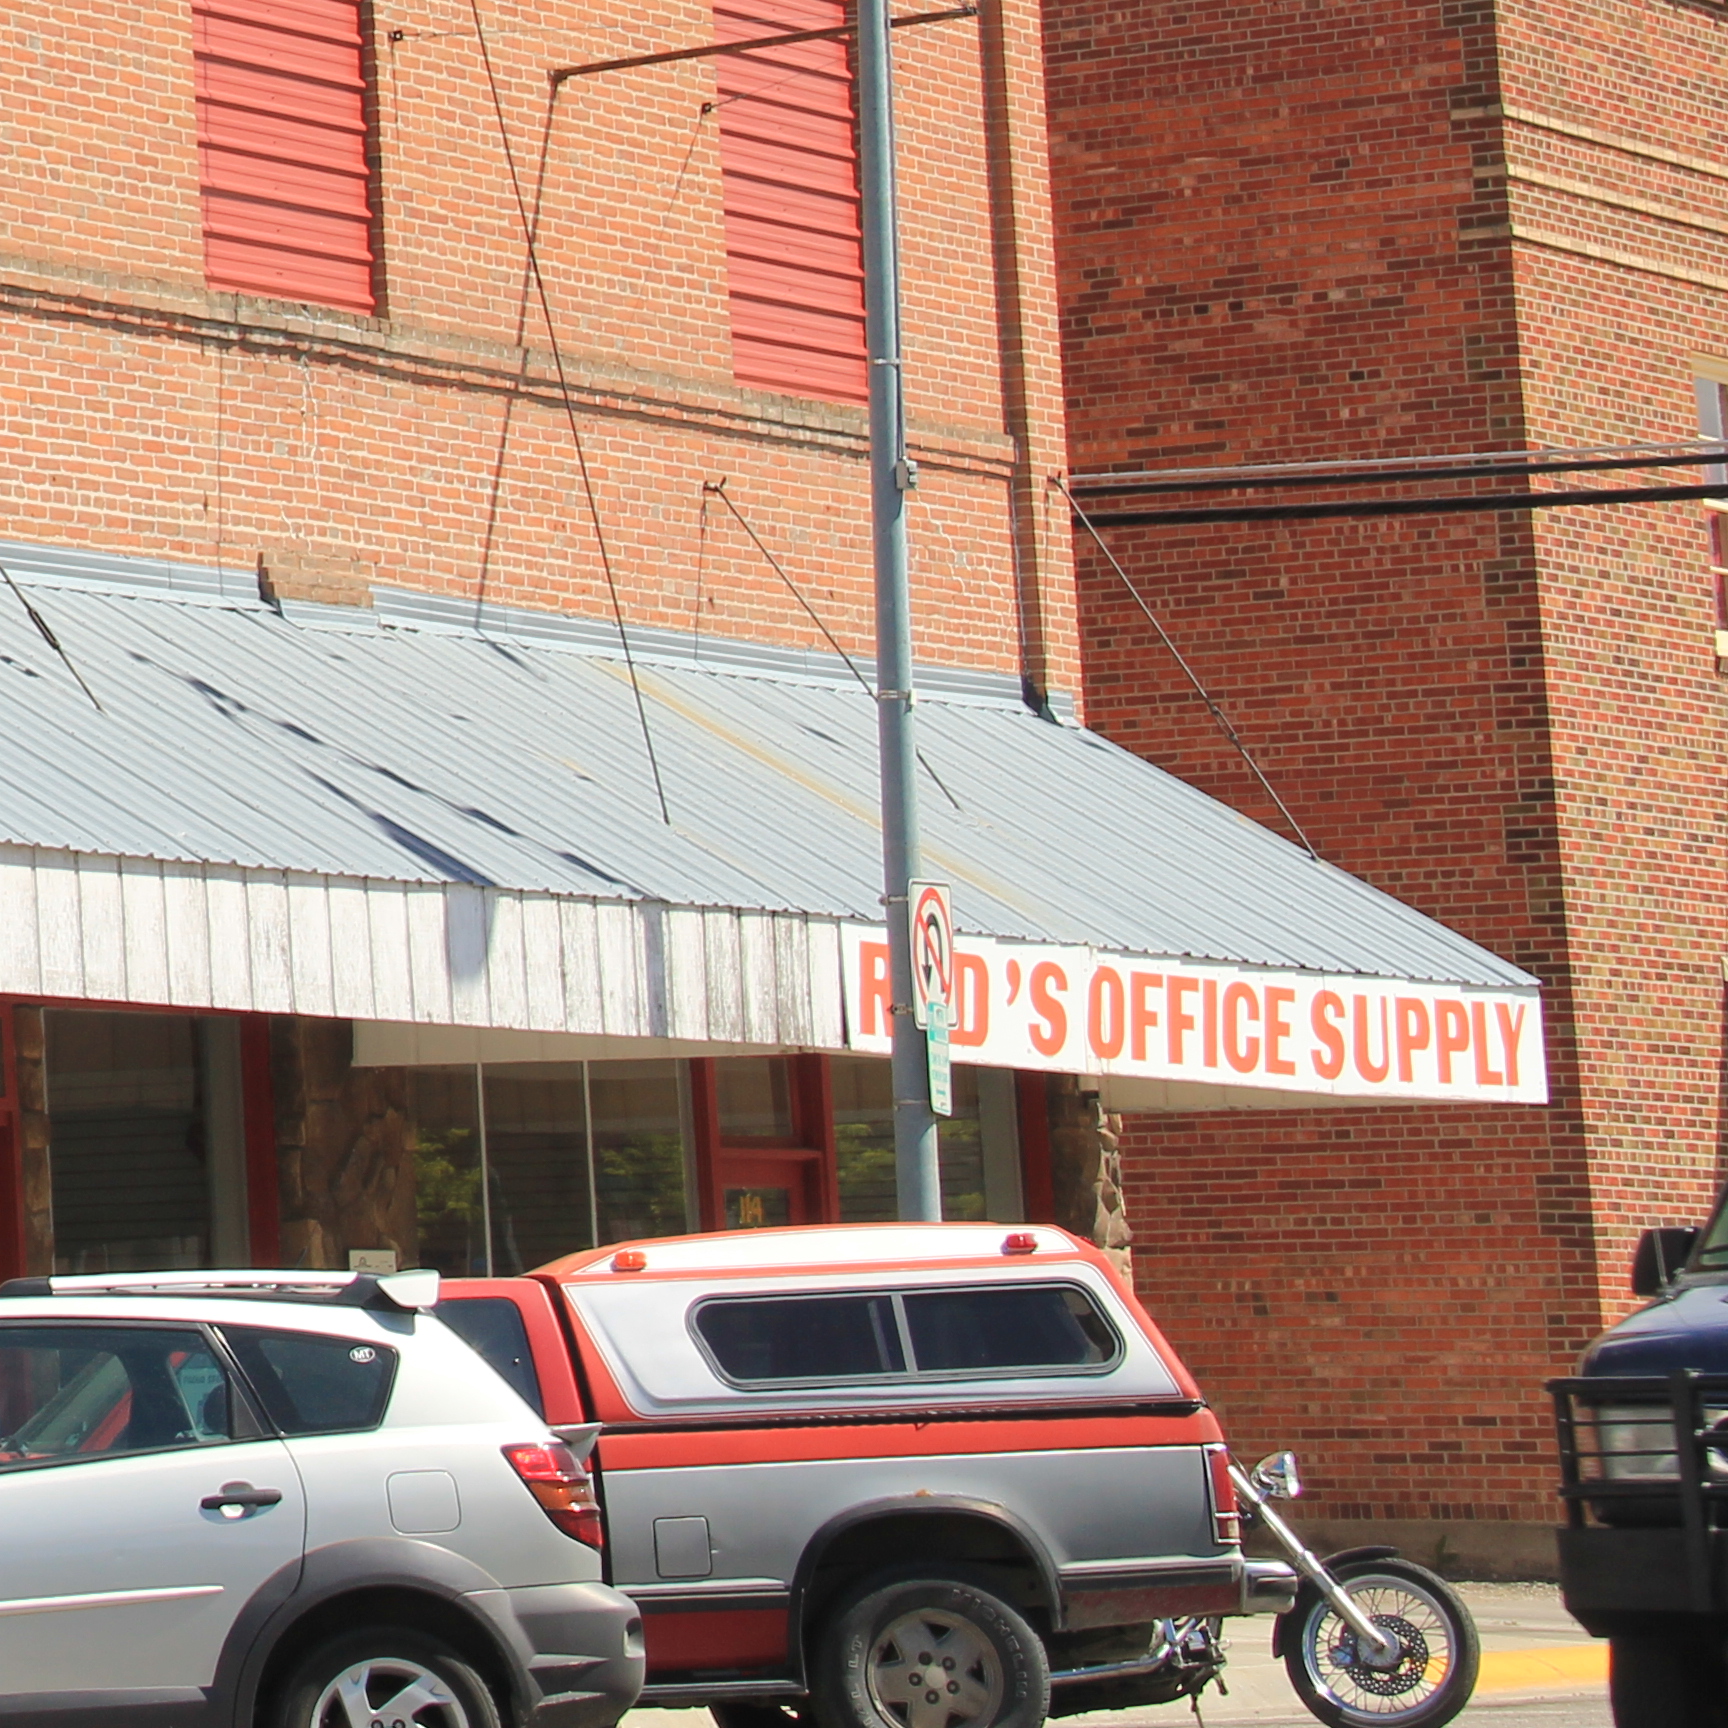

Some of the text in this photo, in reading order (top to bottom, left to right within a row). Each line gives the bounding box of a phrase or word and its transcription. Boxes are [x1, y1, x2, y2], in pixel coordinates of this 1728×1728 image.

[859, 940, 1526, 1087] RD'S OFFICE SUPPLY
